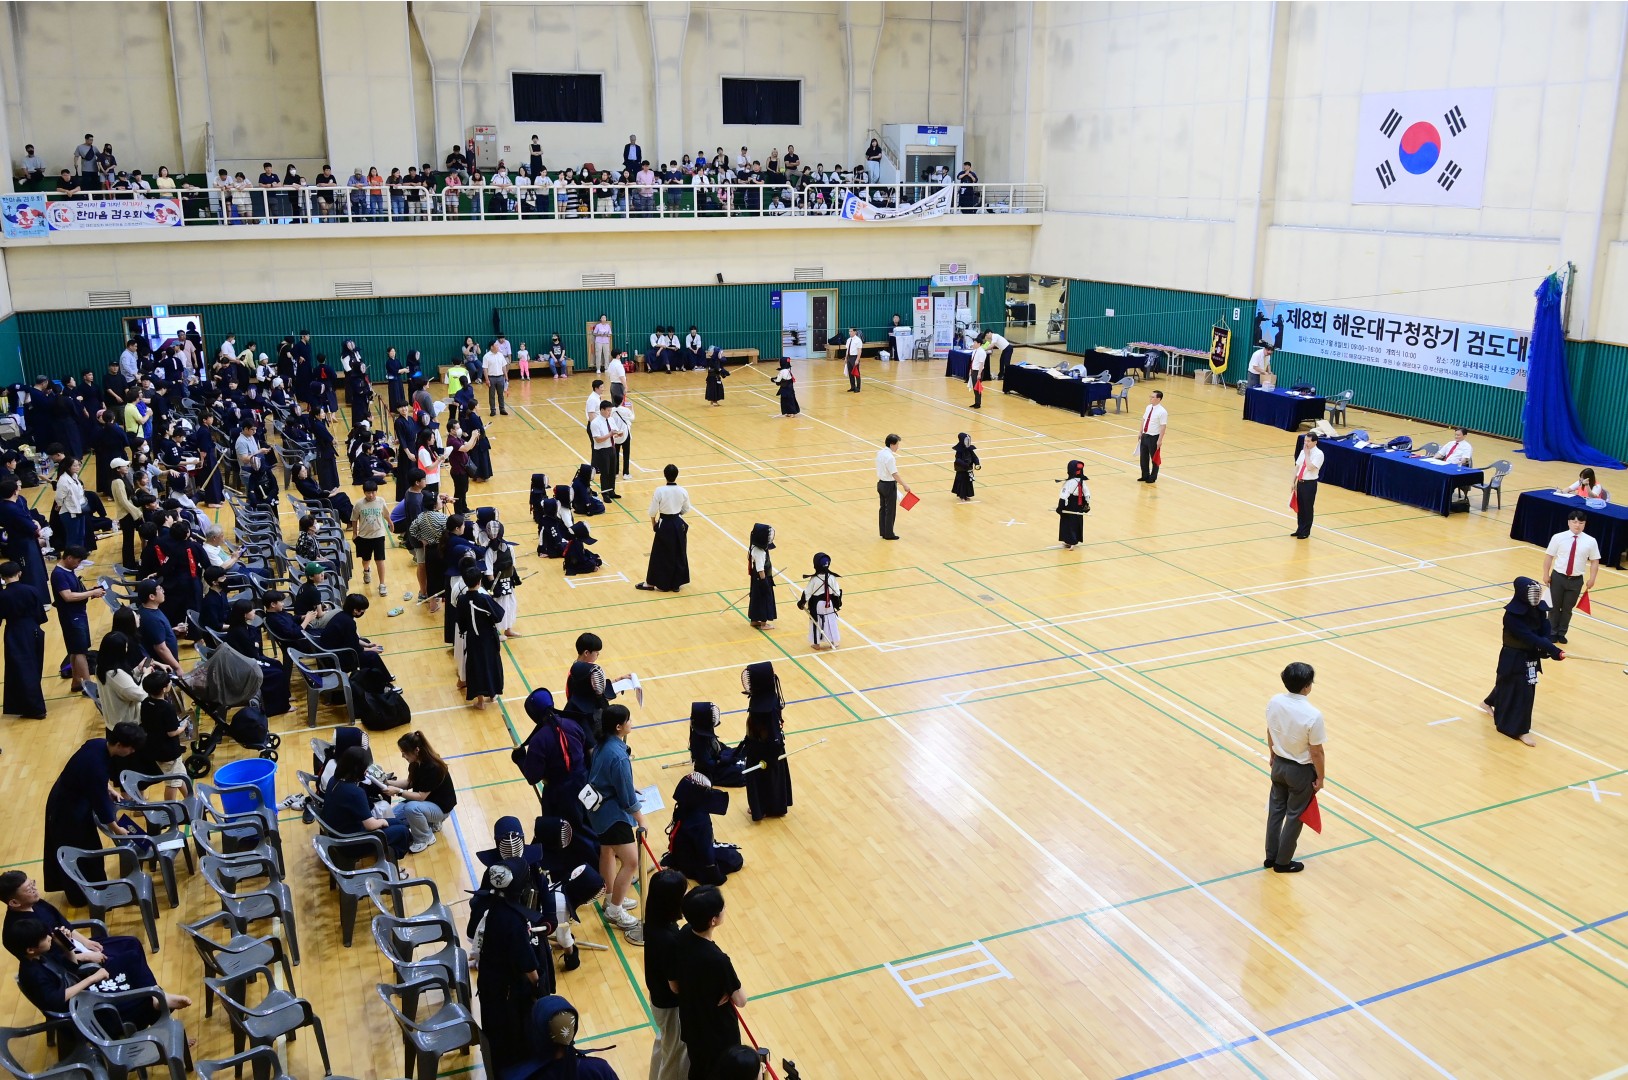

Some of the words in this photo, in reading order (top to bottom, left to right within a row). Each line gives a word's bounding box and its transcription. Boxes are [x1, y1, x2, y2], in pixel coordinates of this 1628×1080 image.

[76, 210, 108, 220] 한마음
[111, 209, 142, 220] 검우회
[1286, 307, 1327, 333] 제8회
[1333, 313, 1460, 352] 해운대구청장기
[1466, 330, 1532, 363] 검도대
[1309, 337, 1325, 346] 2023년
[1326, 339, 1334, 347] 7월
[1386, 348, 1401, 357] 개회식
[1402, 350, 1417, 359] 10:00
[1450, 358, 1461, 367] 기장
[1462, 360, 1490, 372] 실내체육관
[1491, 364, 1497, 373] 내
[1498, 366, 1528, 378] 보조경기장
